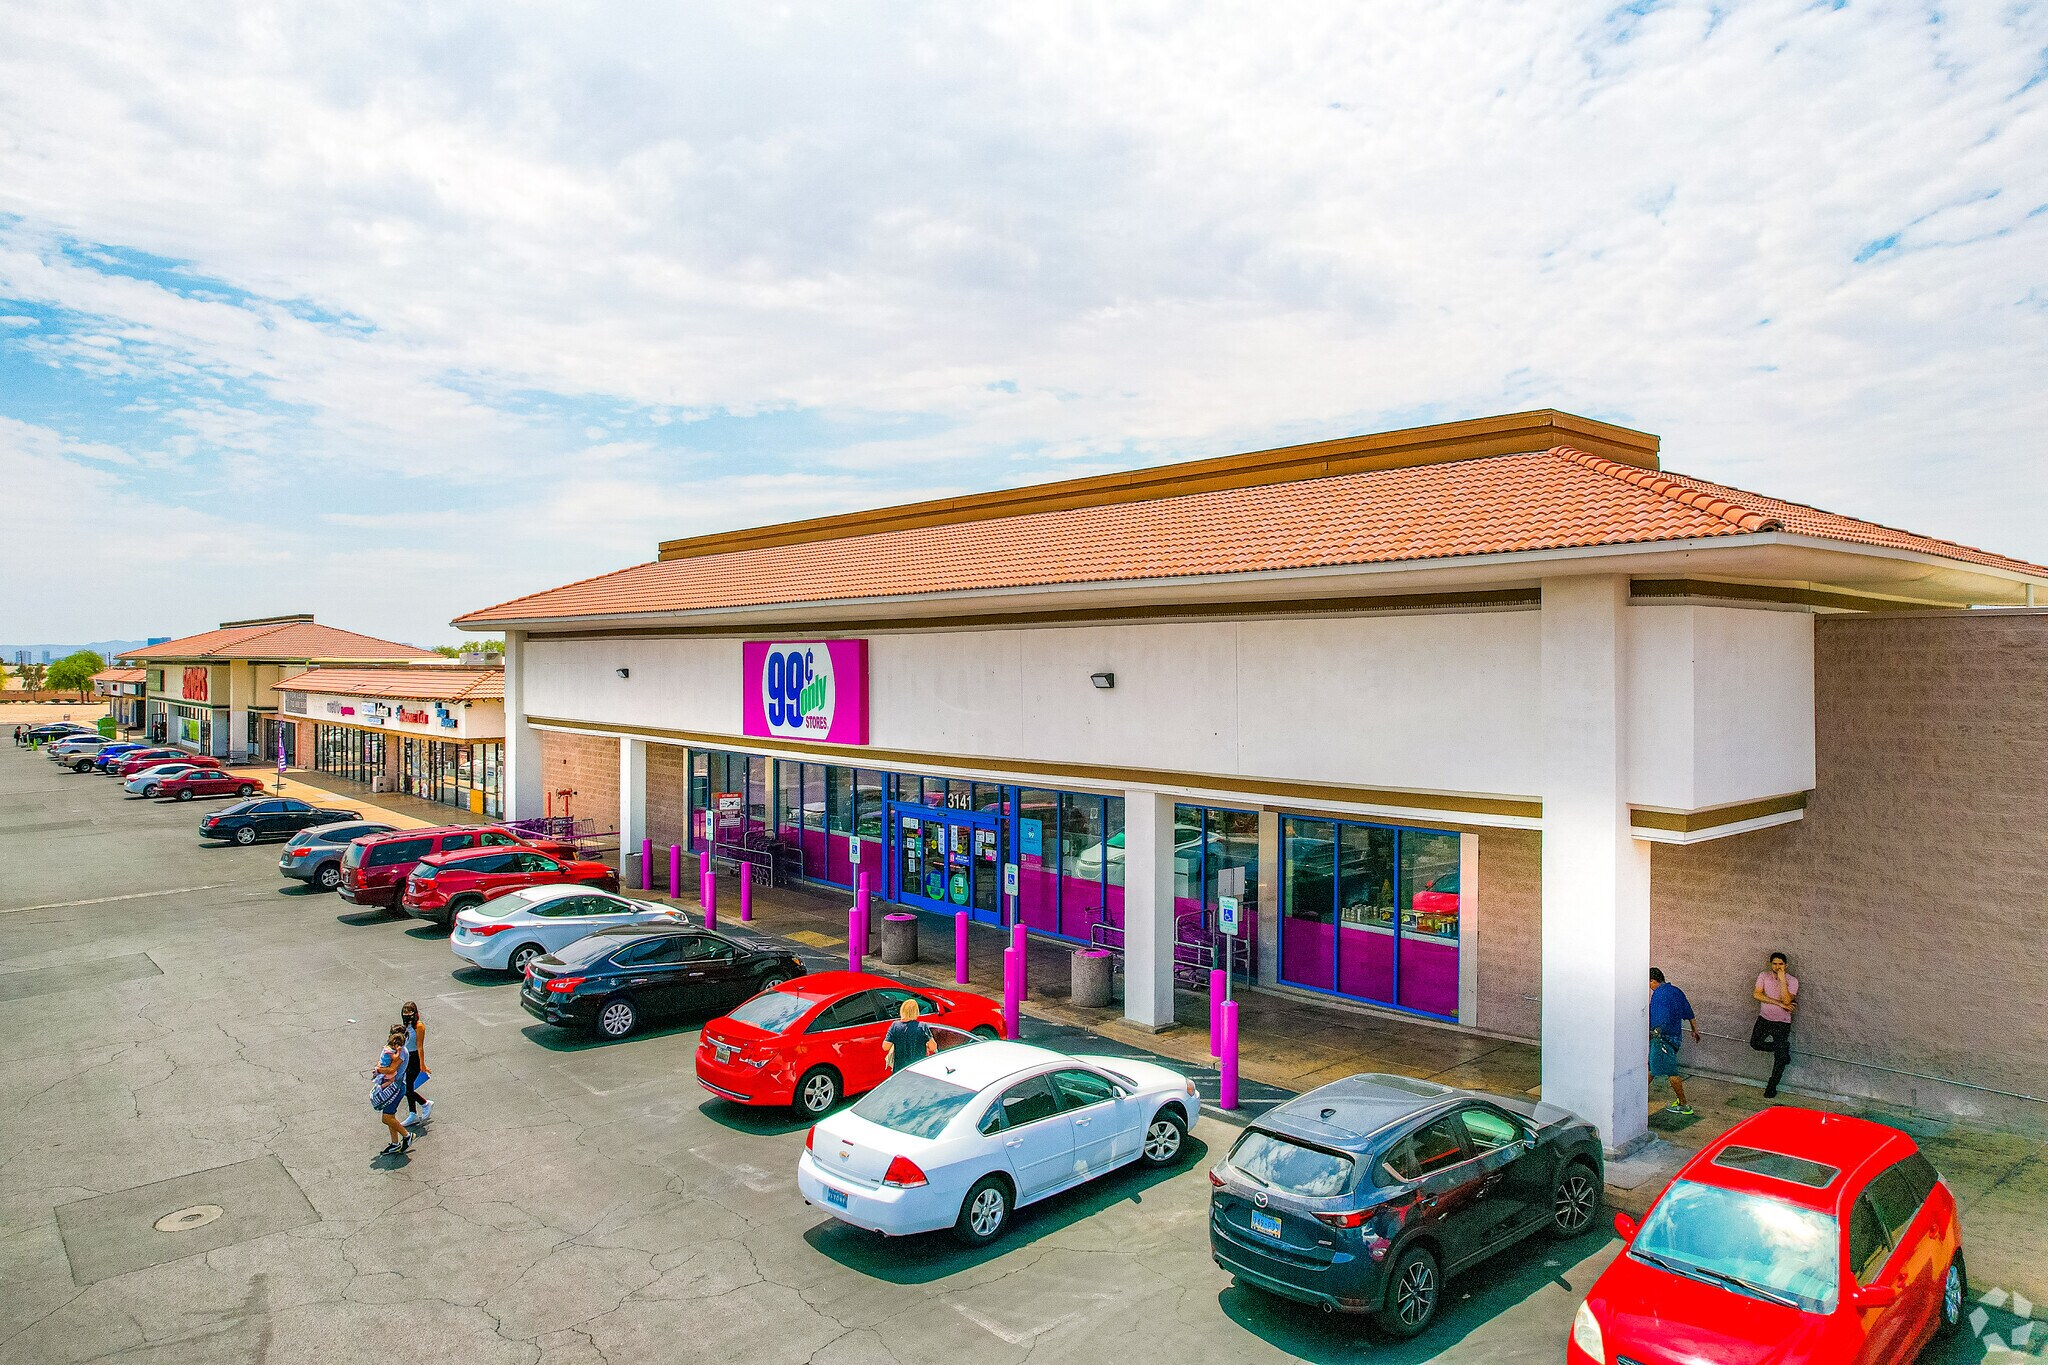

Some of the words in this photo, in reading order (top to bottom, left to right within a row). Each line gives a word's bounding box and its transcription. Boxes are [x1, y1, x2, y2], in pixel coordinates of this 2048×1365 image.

[800, 674, 827, 716] only
[805, 716, 827, 730] STORES
[947, 793, 972, 811] 3141
